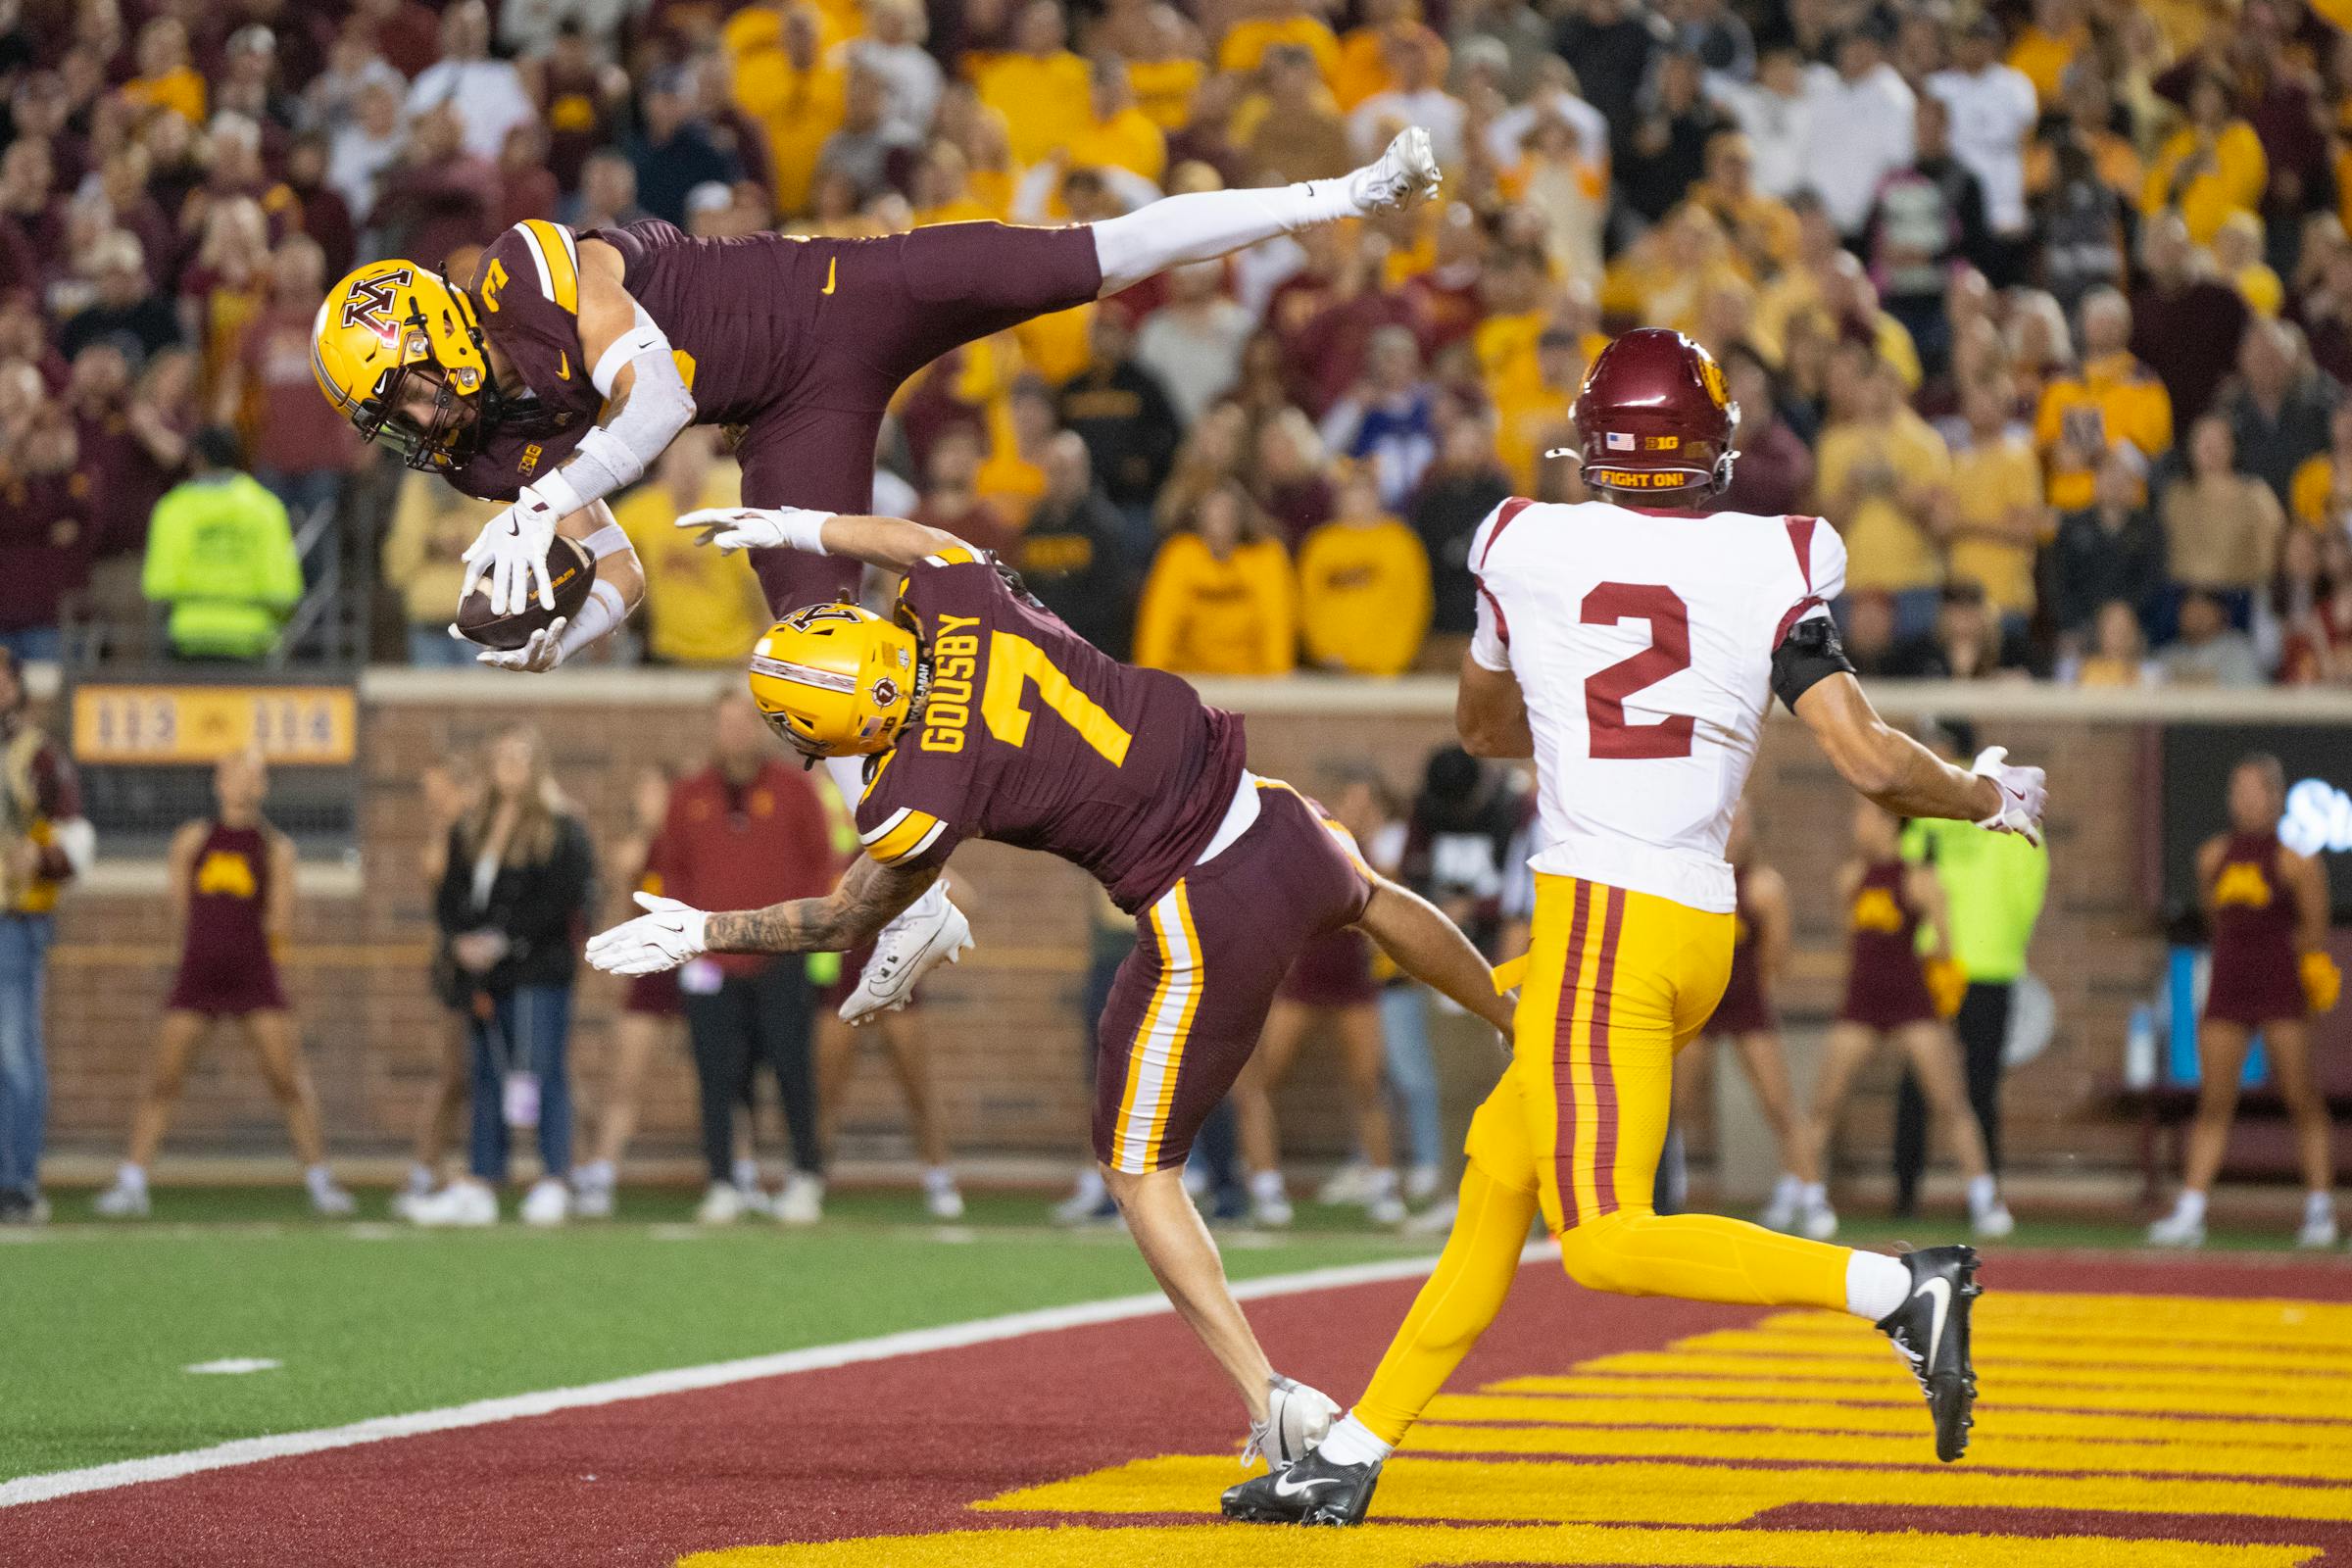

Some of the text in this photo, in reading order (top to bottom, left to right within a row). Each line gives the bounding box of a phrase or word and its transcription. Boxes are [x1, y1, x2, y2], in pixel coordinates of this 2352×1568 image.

[342, 269, 414, 350] M
[1599, 470, 1685, 486] FIGHT ON!
[1644, 436, 1679, 451] B1G
[920, 613, 980, 753] GOUSBY
[981, 629, 1133, 768] 7
[1580, 581, 1695, 760] 2
